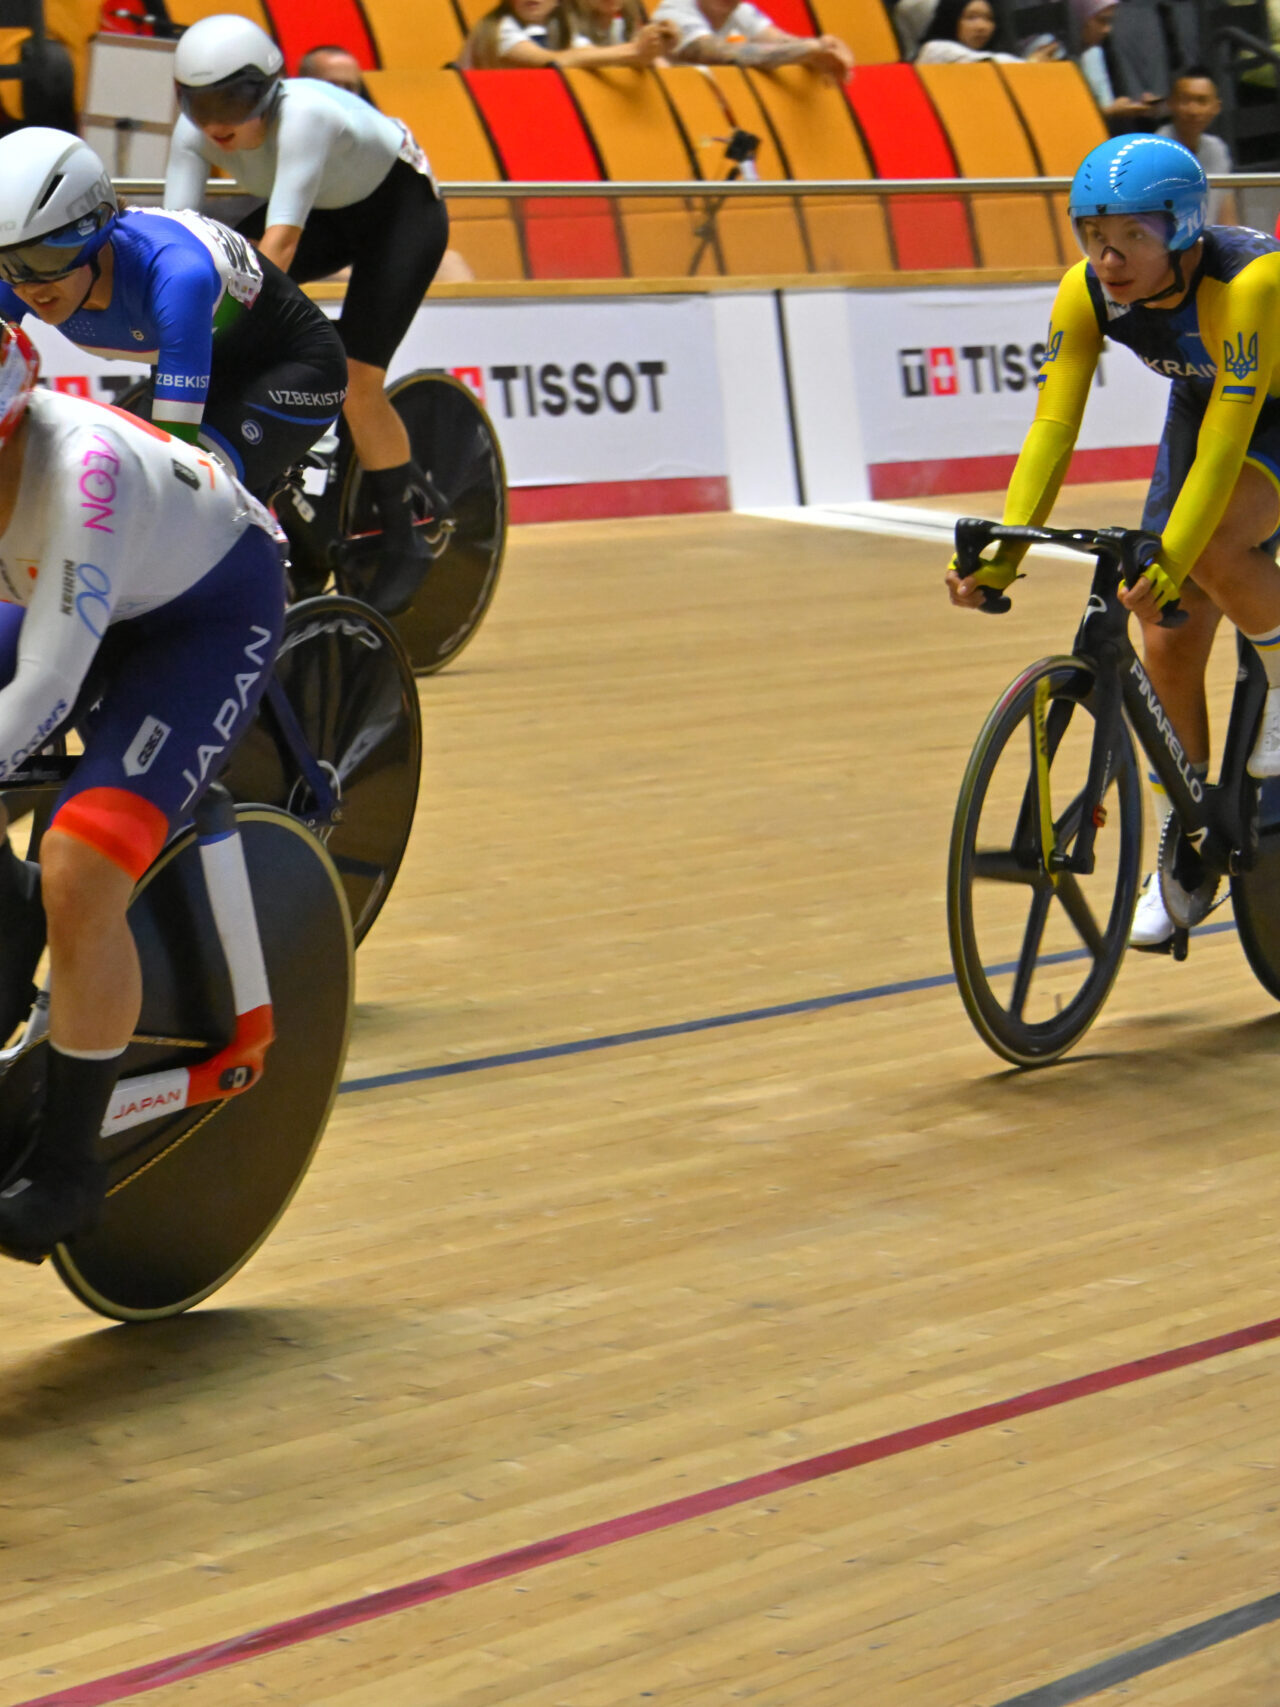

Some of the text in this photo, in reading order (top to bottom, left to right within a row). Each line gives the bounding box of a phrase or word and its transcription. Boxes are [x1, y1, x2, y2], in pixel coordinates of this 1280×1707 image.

[490, 360, 668, 418] TISSOT
[180, 624, 272, 812] JAPAN
[1129, 658, 1204, 804] PINARELLO
[112, 1089, 182, 1120] JAPAN
